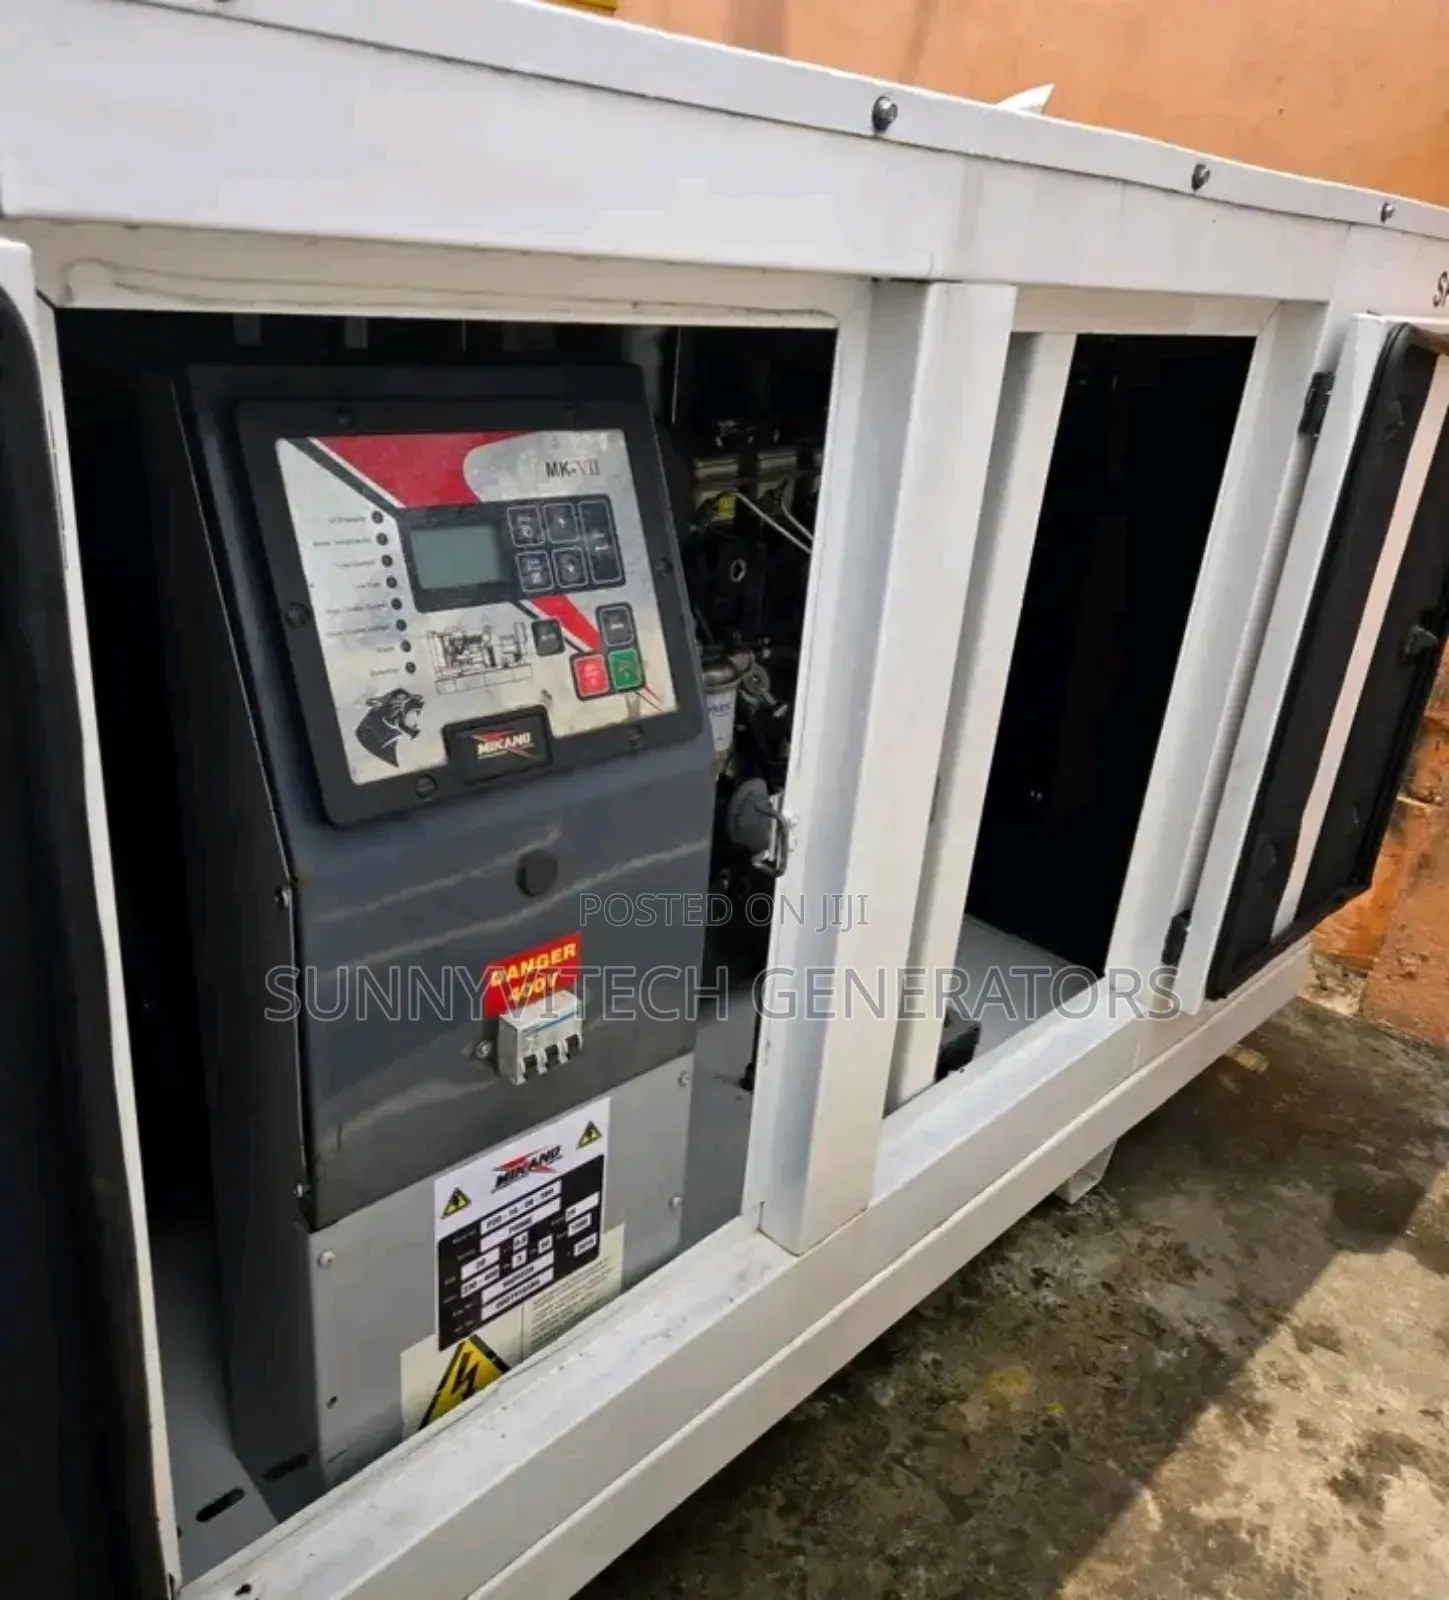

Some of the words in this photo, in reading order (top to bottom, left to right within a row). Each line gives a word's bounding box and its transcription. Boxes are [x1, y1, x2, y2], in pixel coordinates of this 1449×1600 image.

[477, 731, 532, 756] MIKANO
[490, 942, 577, 988] DANGER
[495, 1144, 562, 1190] MIKANO
